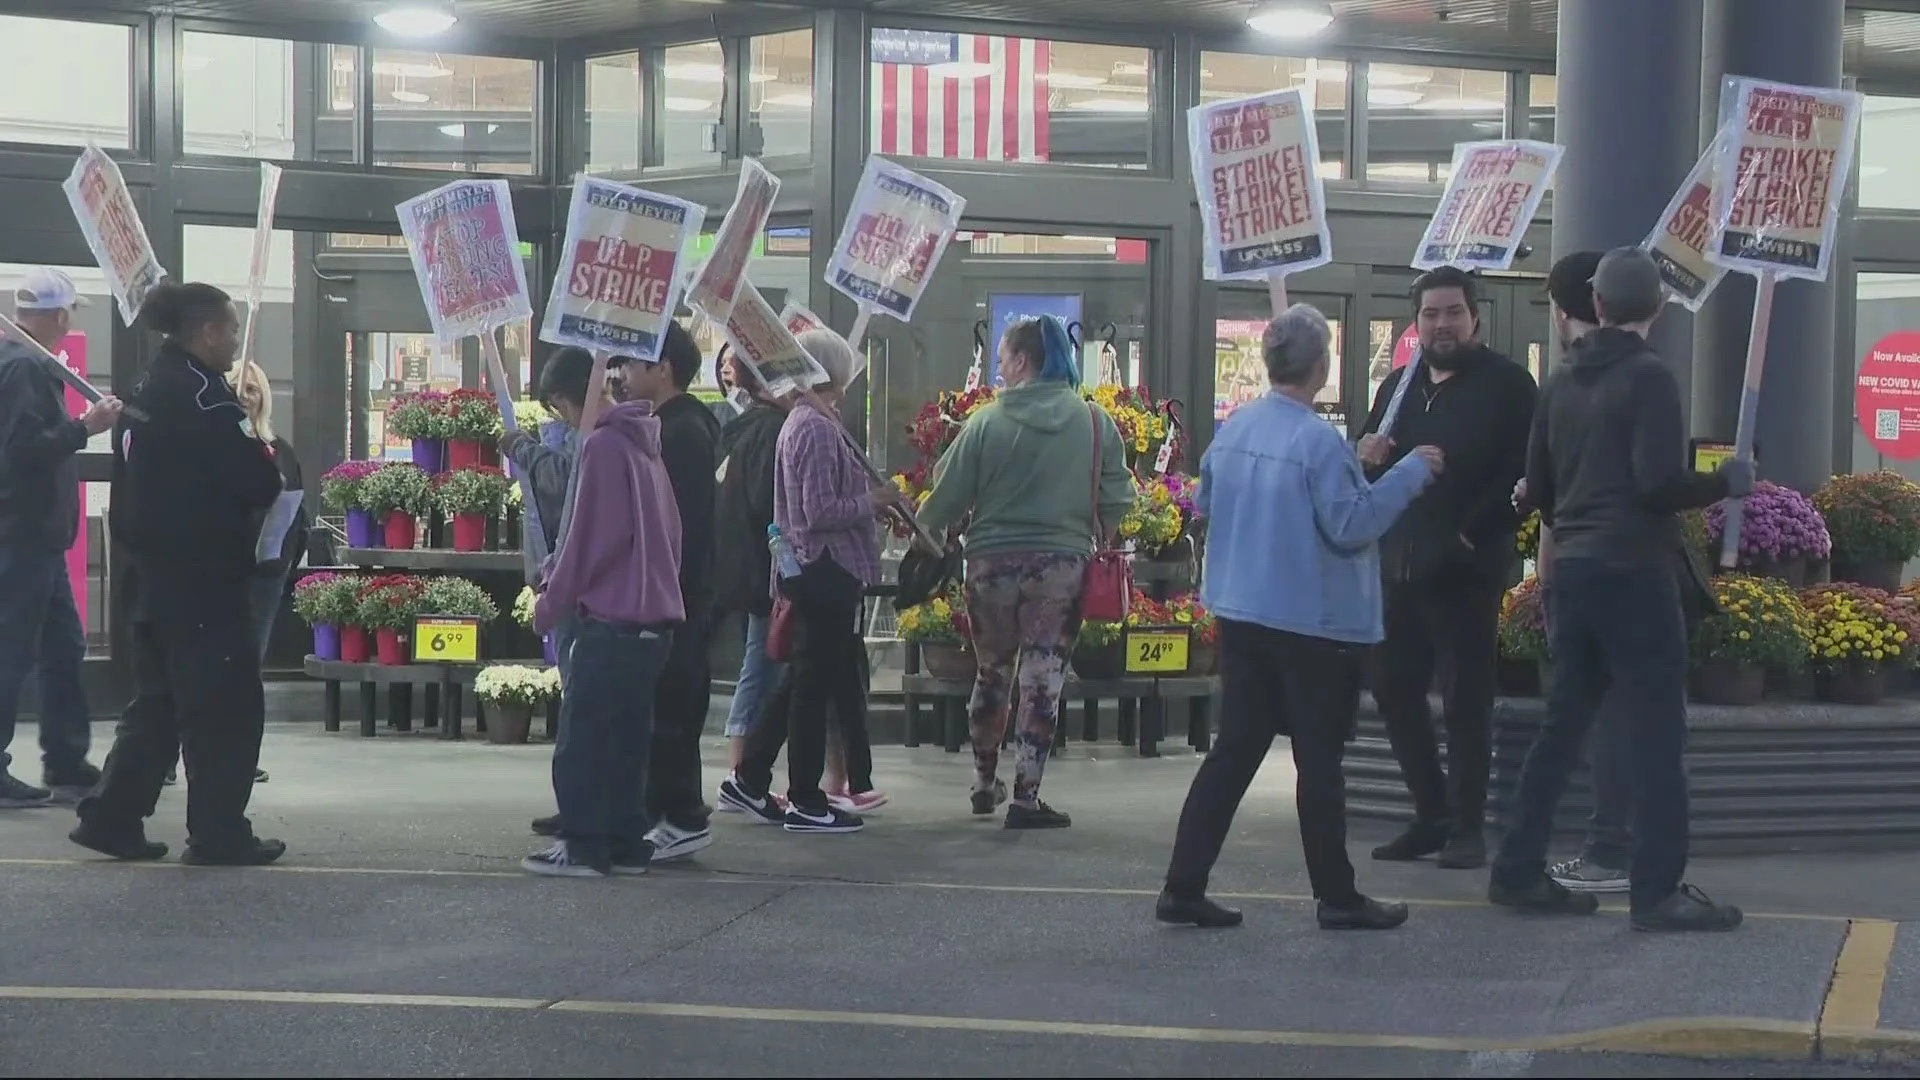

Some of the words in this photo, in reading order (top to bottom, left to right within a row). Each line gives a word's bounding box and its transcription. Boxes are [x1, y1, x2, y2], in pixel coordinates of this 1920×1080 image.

[1213, 143, 1304, 193] STRIKE!
[1736, 146, 1836, 176] STRIKE!
[590, 193, 629, 212] FRED
[632, 204, 683, 225] MEYER
[1215, 168, 1308, 217] STRIKE!
[1219, 193, 1312, 244] STRIKE!
[1729, 198, 1826, 229] STRIKE!
[597, 235, 651, 274] U.L.P.
[848, 230, 929, 284] STRE
[570, 262, 667, 315] STRIKE
[1873, 350, 1893, 361] Now
[1859, 376, 1879, 387] NEW
[1880, 377, 1910, 389] COVID
